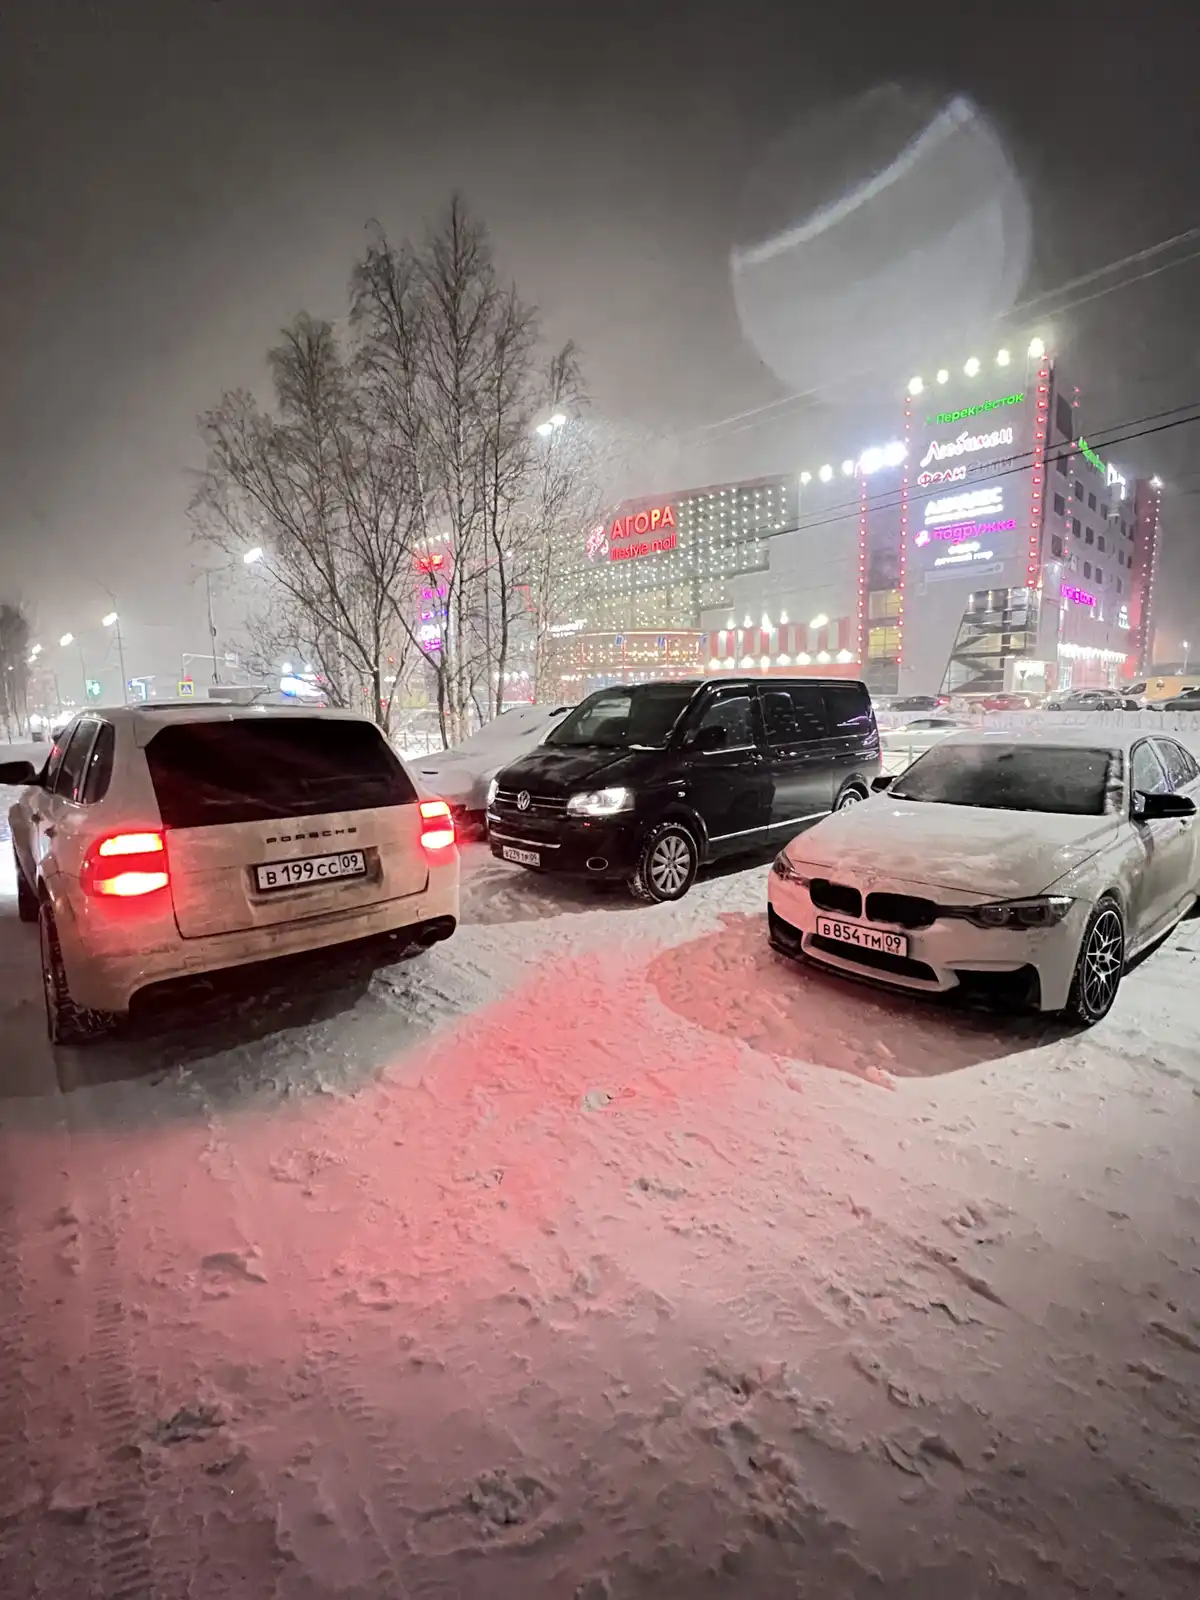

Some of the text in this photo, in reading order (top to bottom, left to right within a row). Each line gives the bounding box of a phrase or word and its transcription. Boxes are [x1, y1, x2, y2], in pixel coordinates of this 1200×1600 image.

[935, 392, 1024, 425] Перекрёсток
[611, 505, 676, 541] АГОРА
[933, 518, 1016, 544] подружка
[651, 532, 677, 552] mall
[266, 827, 357, 844] PORSCHE
